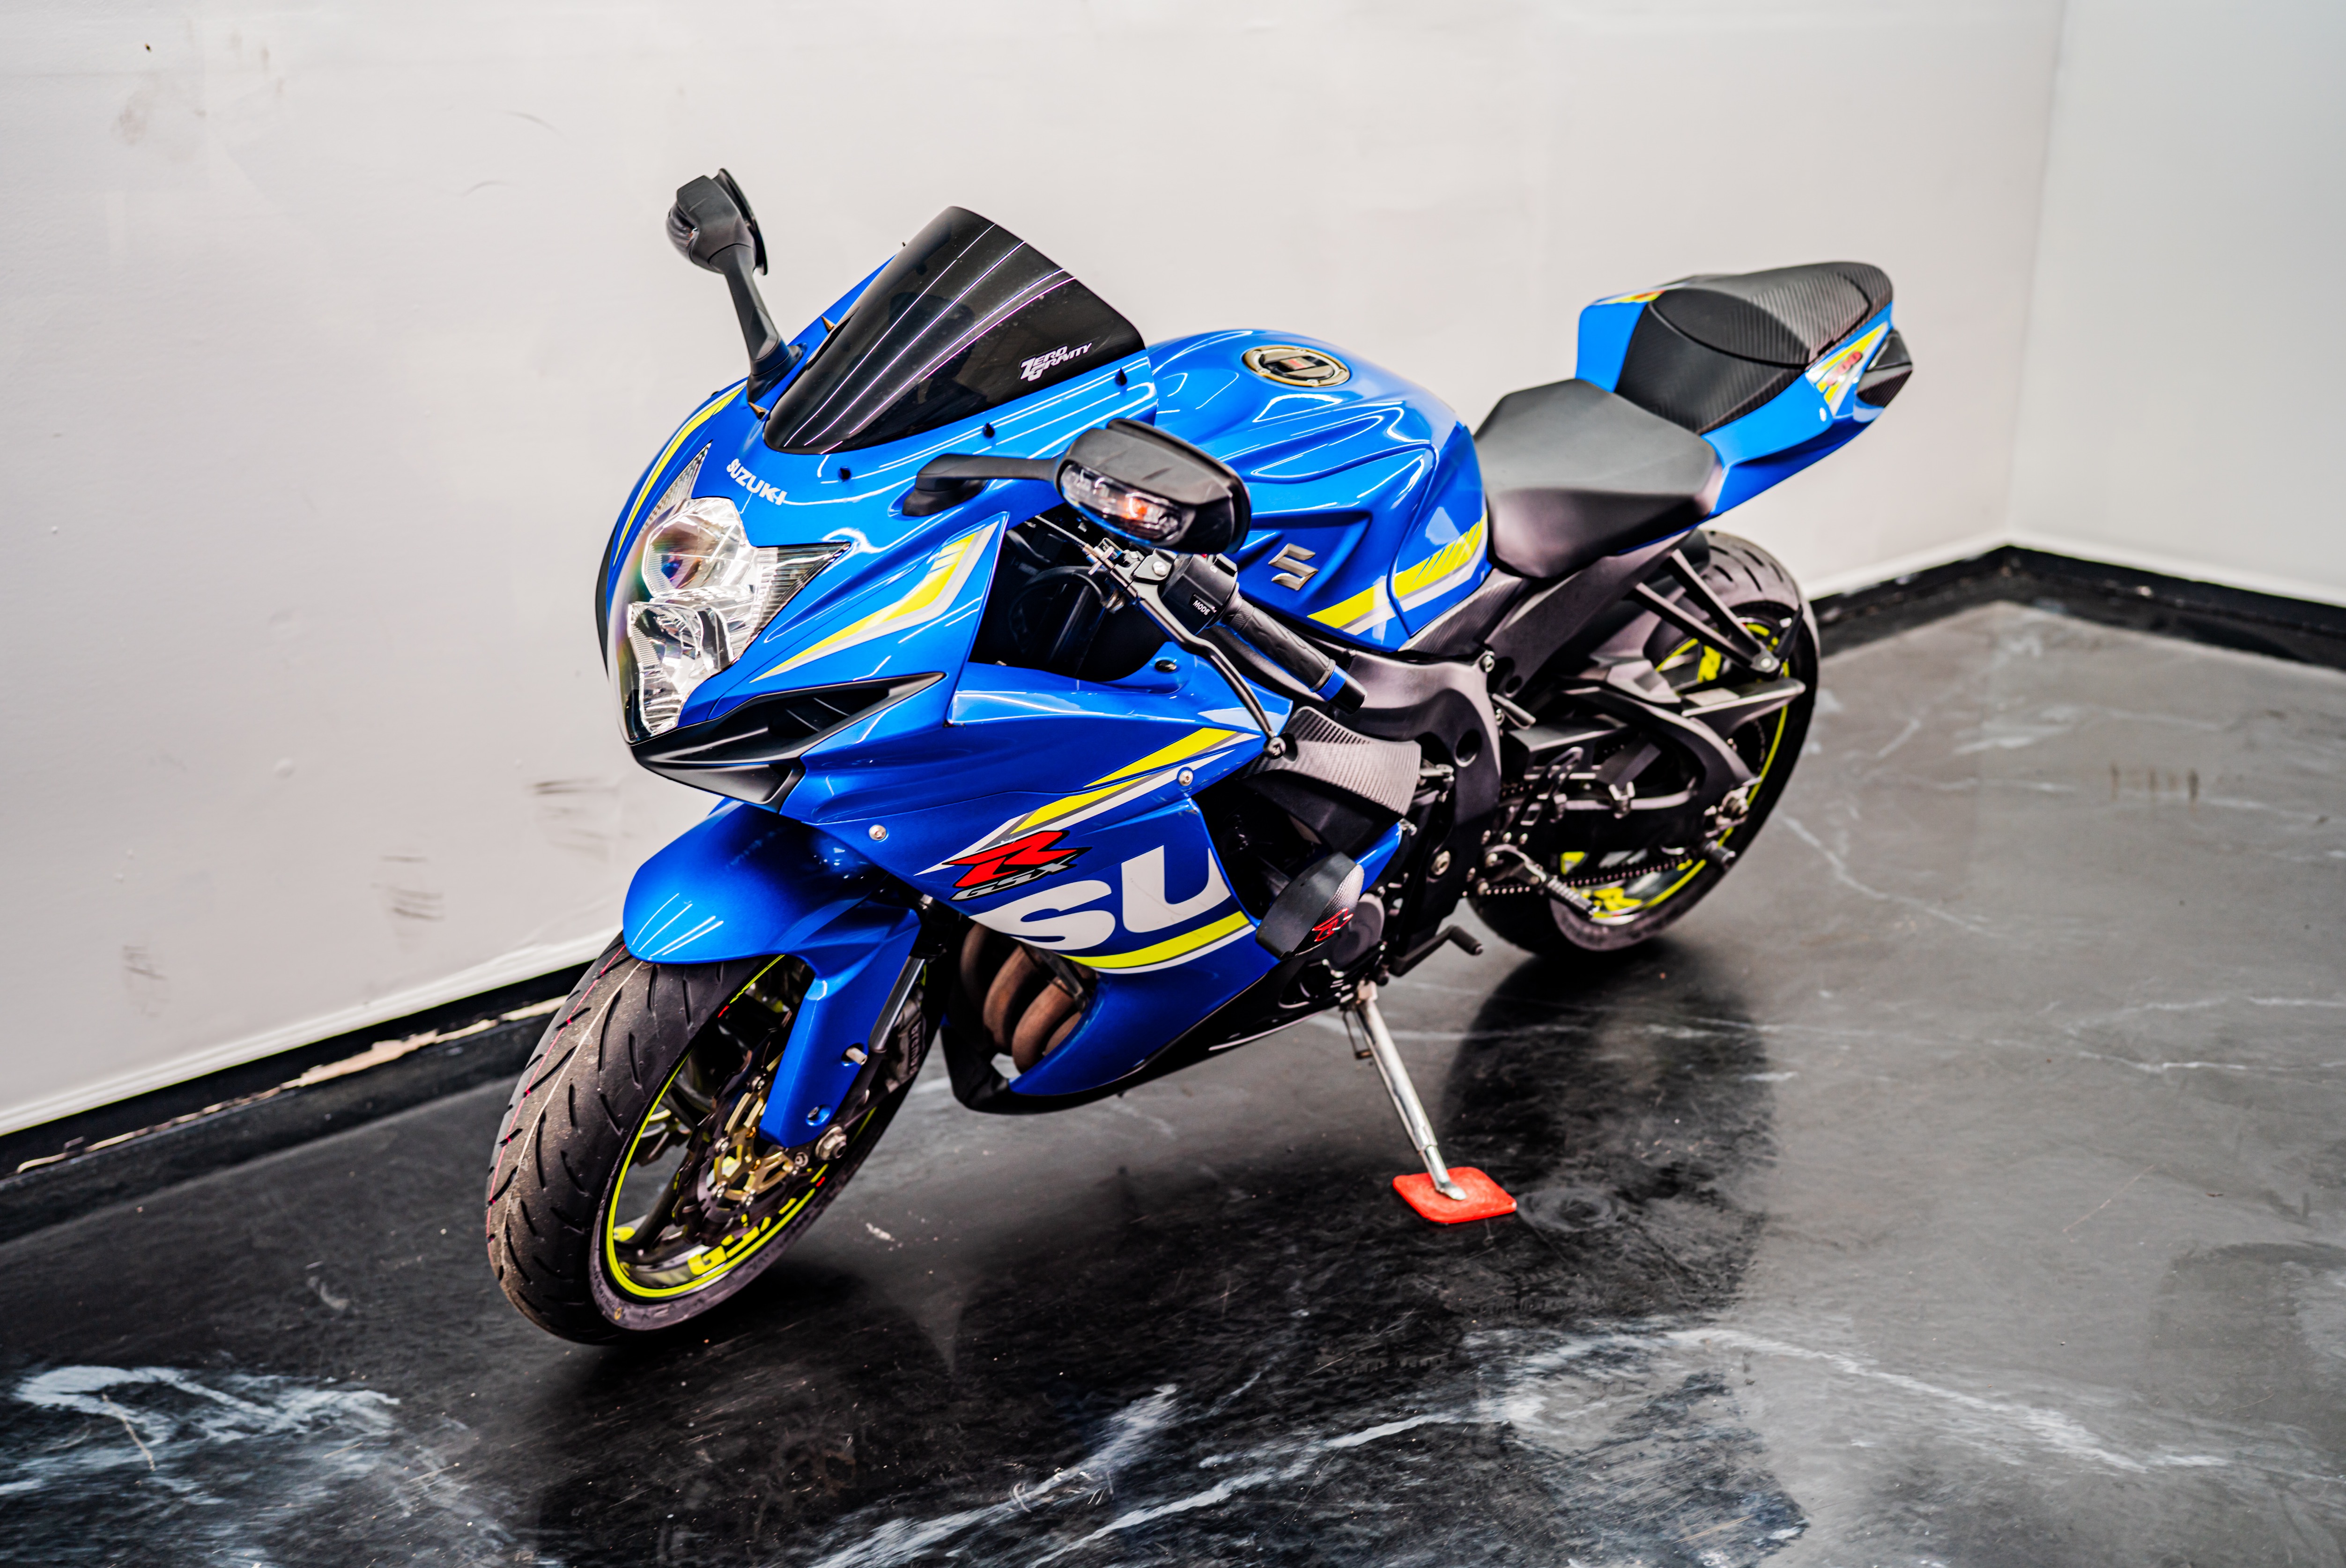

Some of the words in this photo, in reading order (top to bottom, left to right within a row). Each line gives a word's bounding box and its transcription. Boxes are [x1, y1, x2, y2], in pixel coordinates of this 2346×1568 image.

[1020, 346, 1068, 380] ZERO
[1027, 342, 1092, 382] GRAVITY
[726, 458, 788, 506] SUZUKI
[1192, 599, 1211, 615] MODE
[950, 853, 1079, 900] GSX
